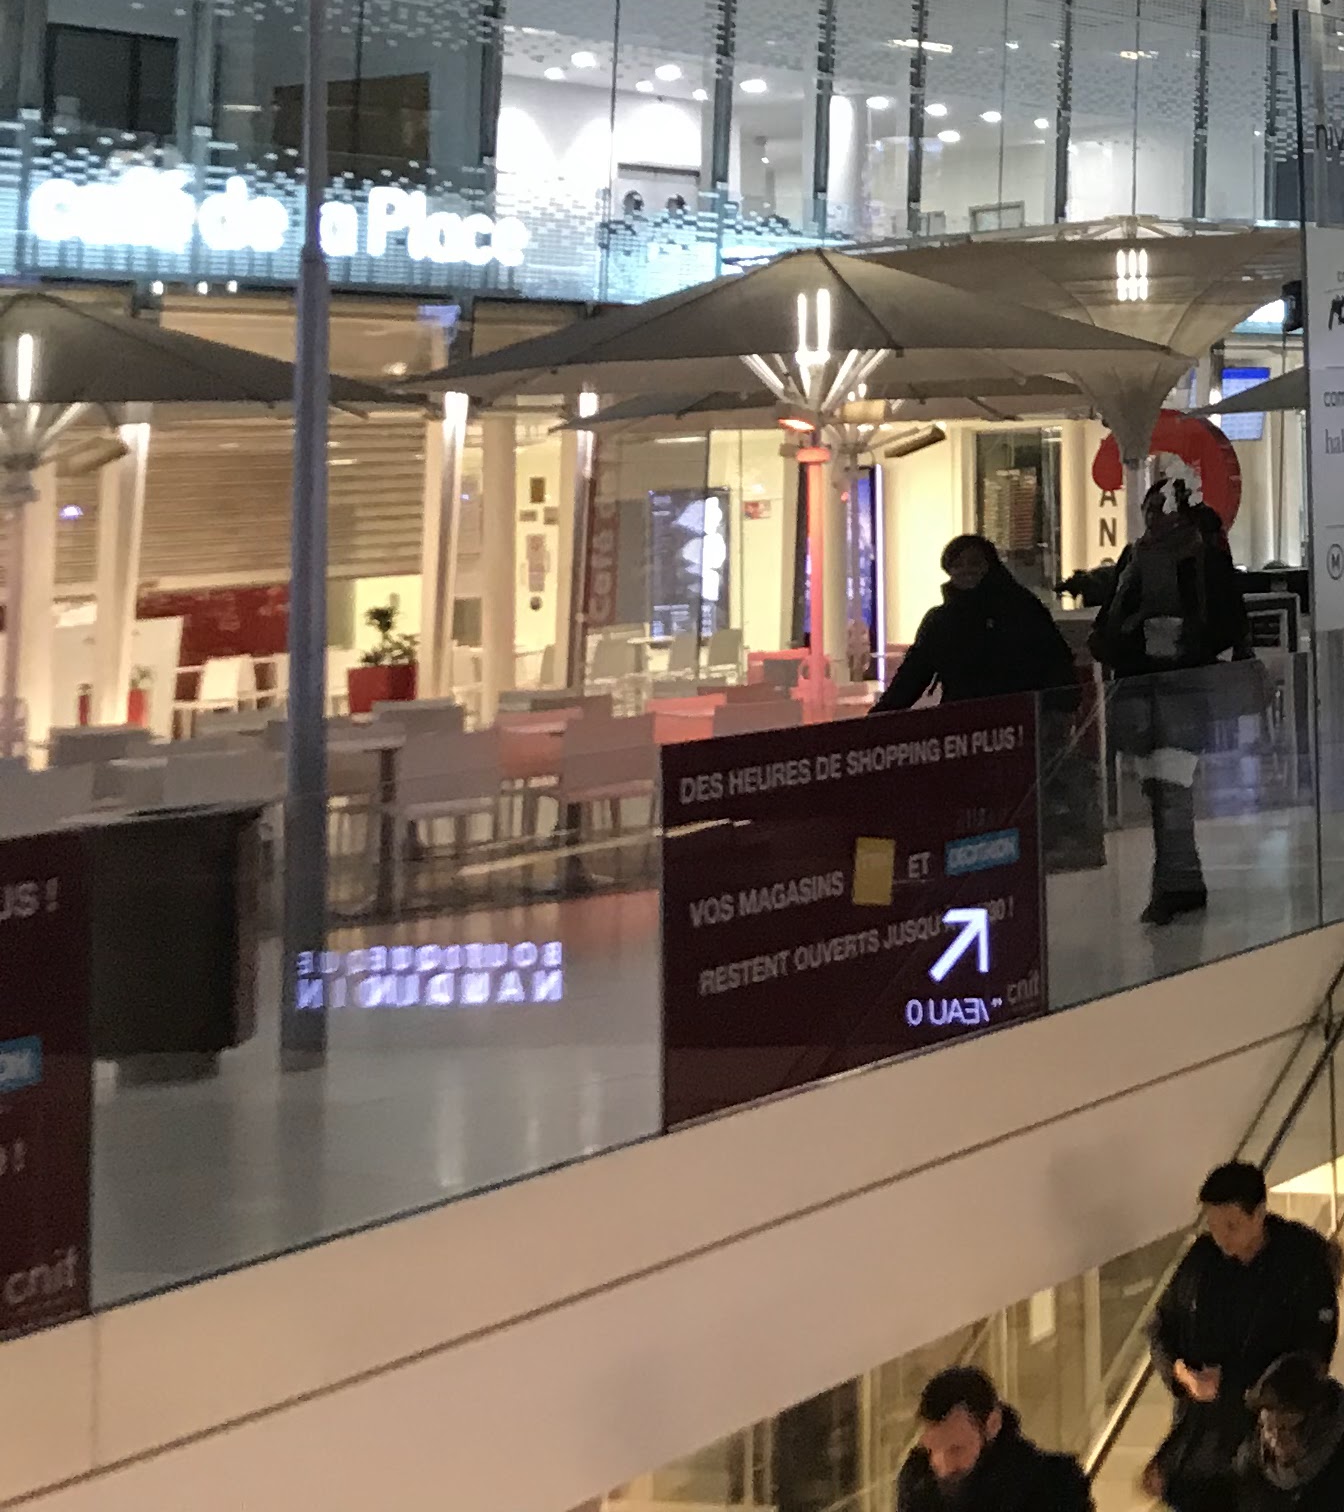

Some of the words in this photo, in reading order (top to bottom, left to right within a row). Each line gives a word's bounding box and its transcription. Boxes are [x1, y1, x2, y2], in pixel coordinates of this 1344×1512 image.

[366, 186, 531, 267] Place
[679, 774, 724, 804] DES
[728, 758, 811, 795] HEURES
[816, 752, 841, 781] DE
[846, 739, 940, 776] SHOPPING
[944, 734, 968, 758] EN
[689, 895, 734, 928] VOS
[739, 870, 844, 915] MAGASINS
[908, 851, 931, 879] ET
[699, 950, 789, 996] RESTENT
[794, 928, 880, 971] OUVERTS
